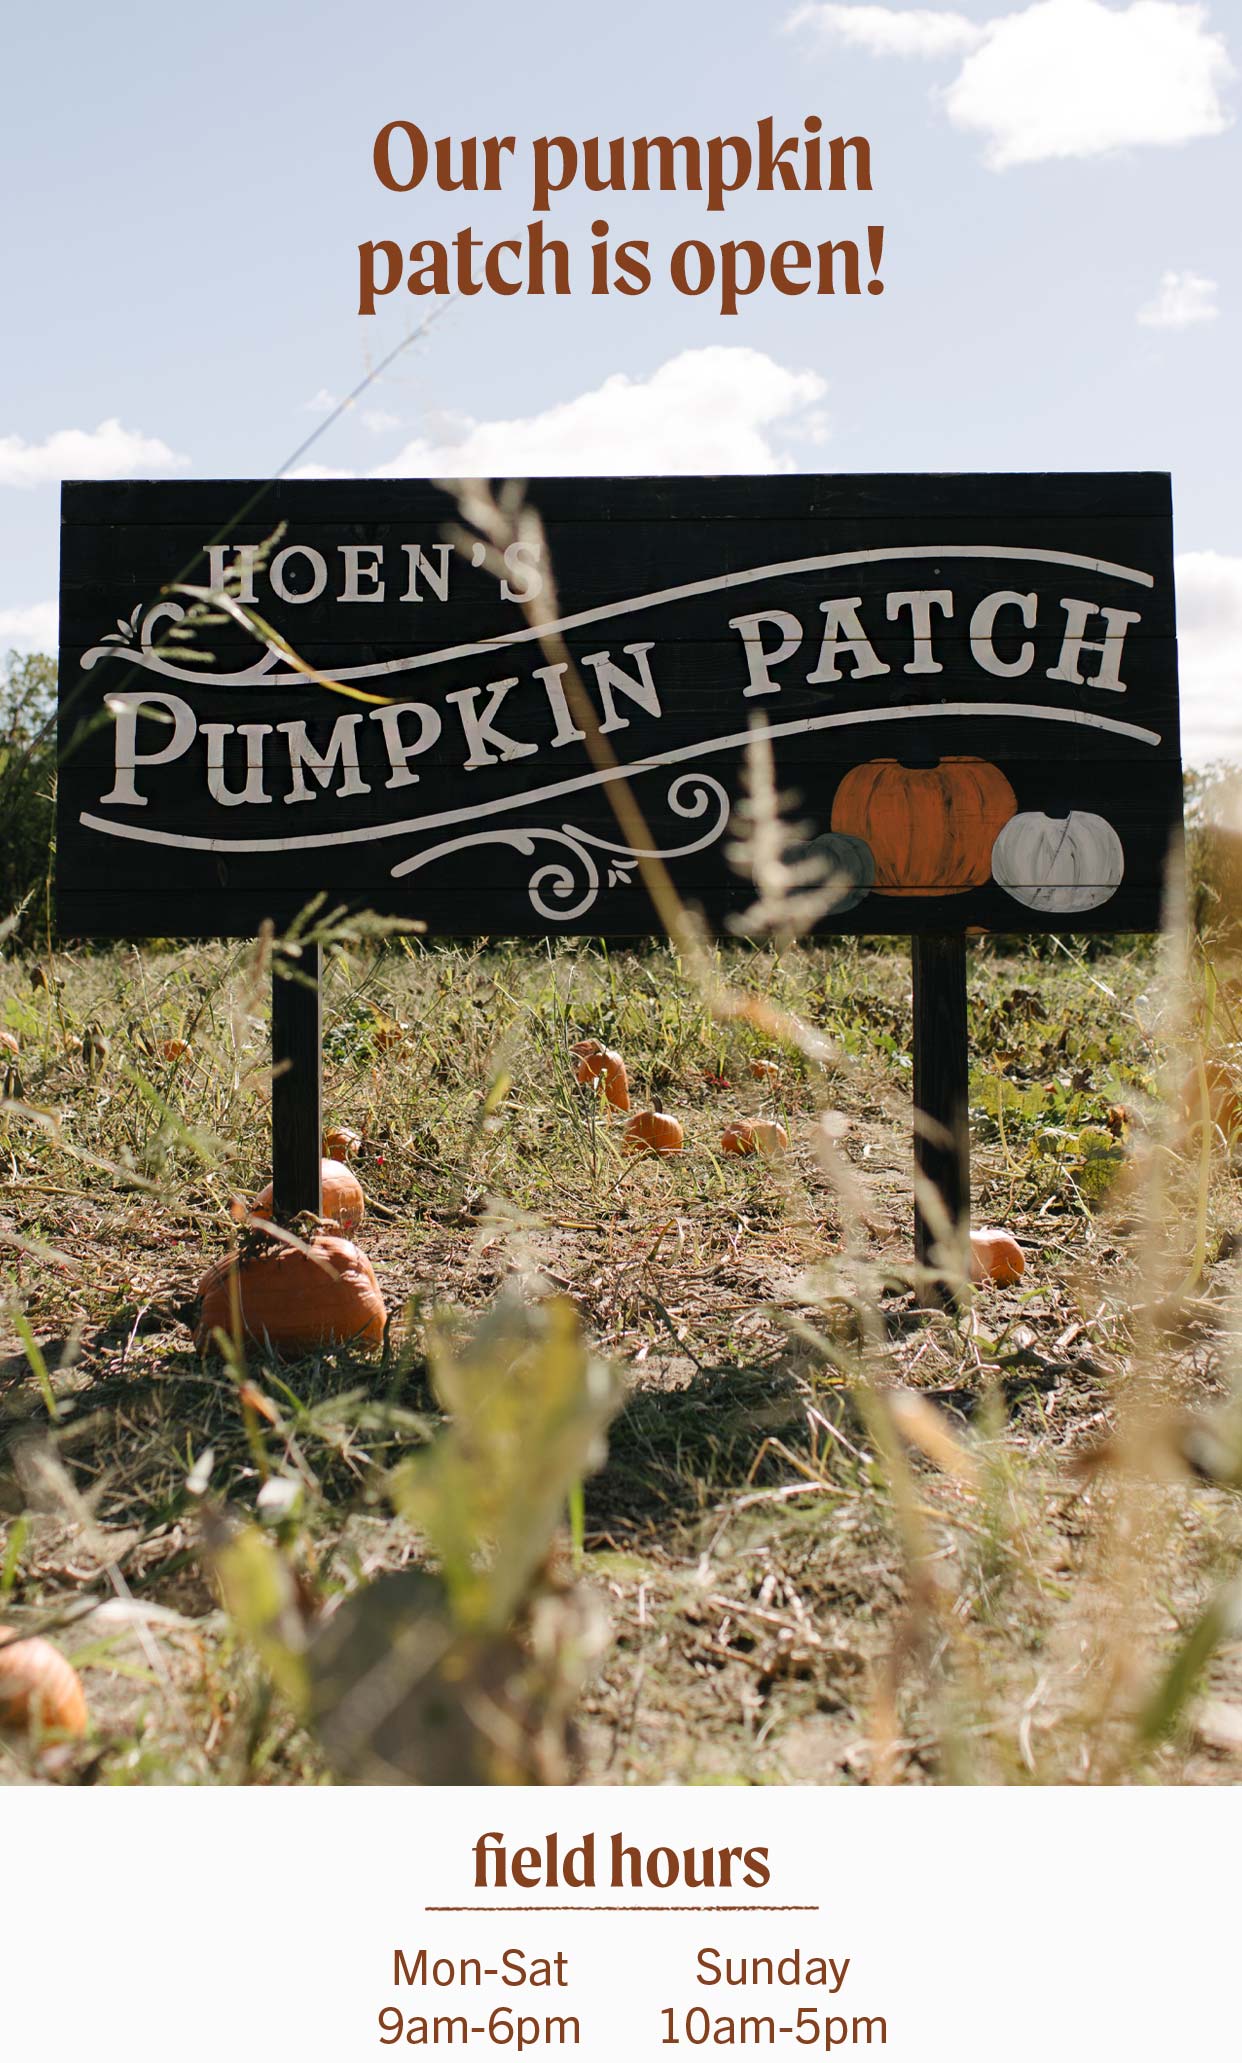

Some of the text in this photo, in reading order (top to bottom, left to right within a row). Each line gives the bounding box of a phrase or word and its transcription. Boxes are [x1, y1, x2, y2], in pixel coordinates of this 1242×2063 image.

[203, 541, 544, 604] HOEN'S
[100, 589, 1142, 806] PUMPKIN PATCH
